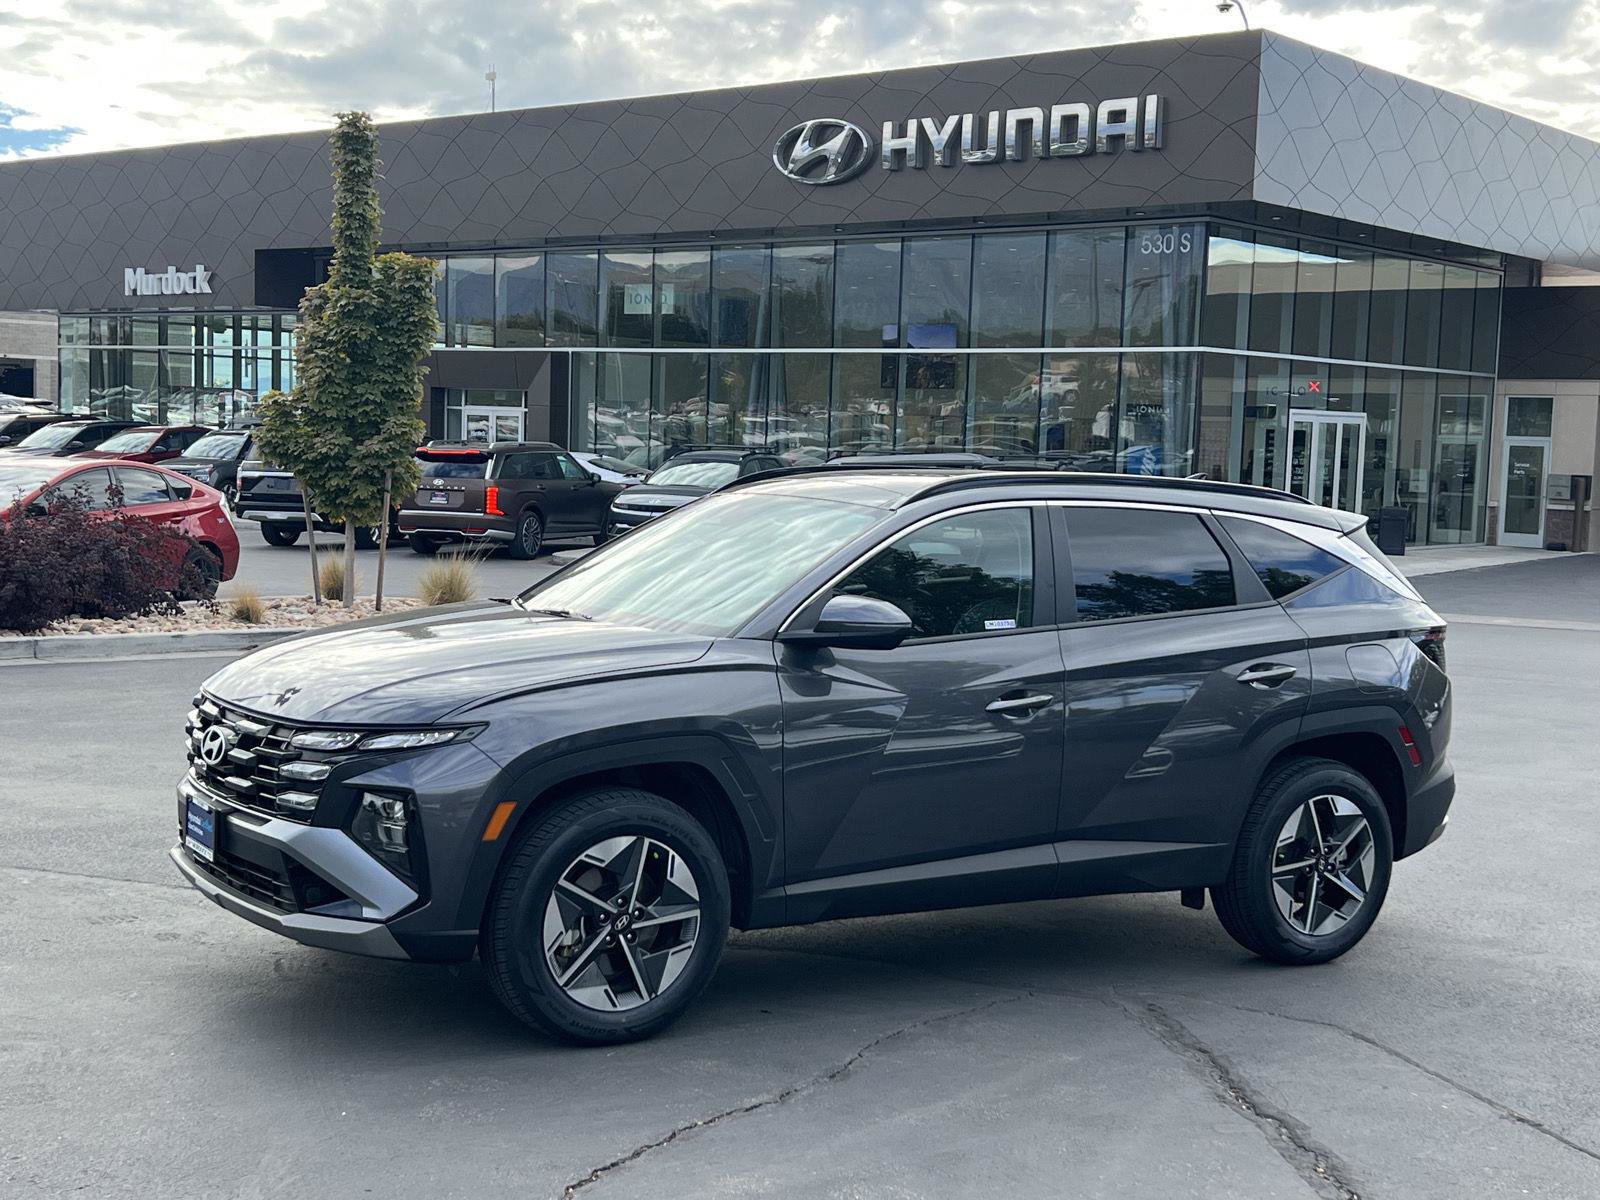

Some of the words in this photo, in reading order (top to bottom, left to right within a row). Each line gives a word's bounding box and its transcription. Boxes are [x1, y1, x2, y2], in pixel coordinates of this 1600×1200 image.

[882, 94, 1162, 171] HYUNDAI
[1141, 234, 1174, 254] 530
[1180, 233, 1191, 252] S
[124, 264, 213, 296] Murdock
